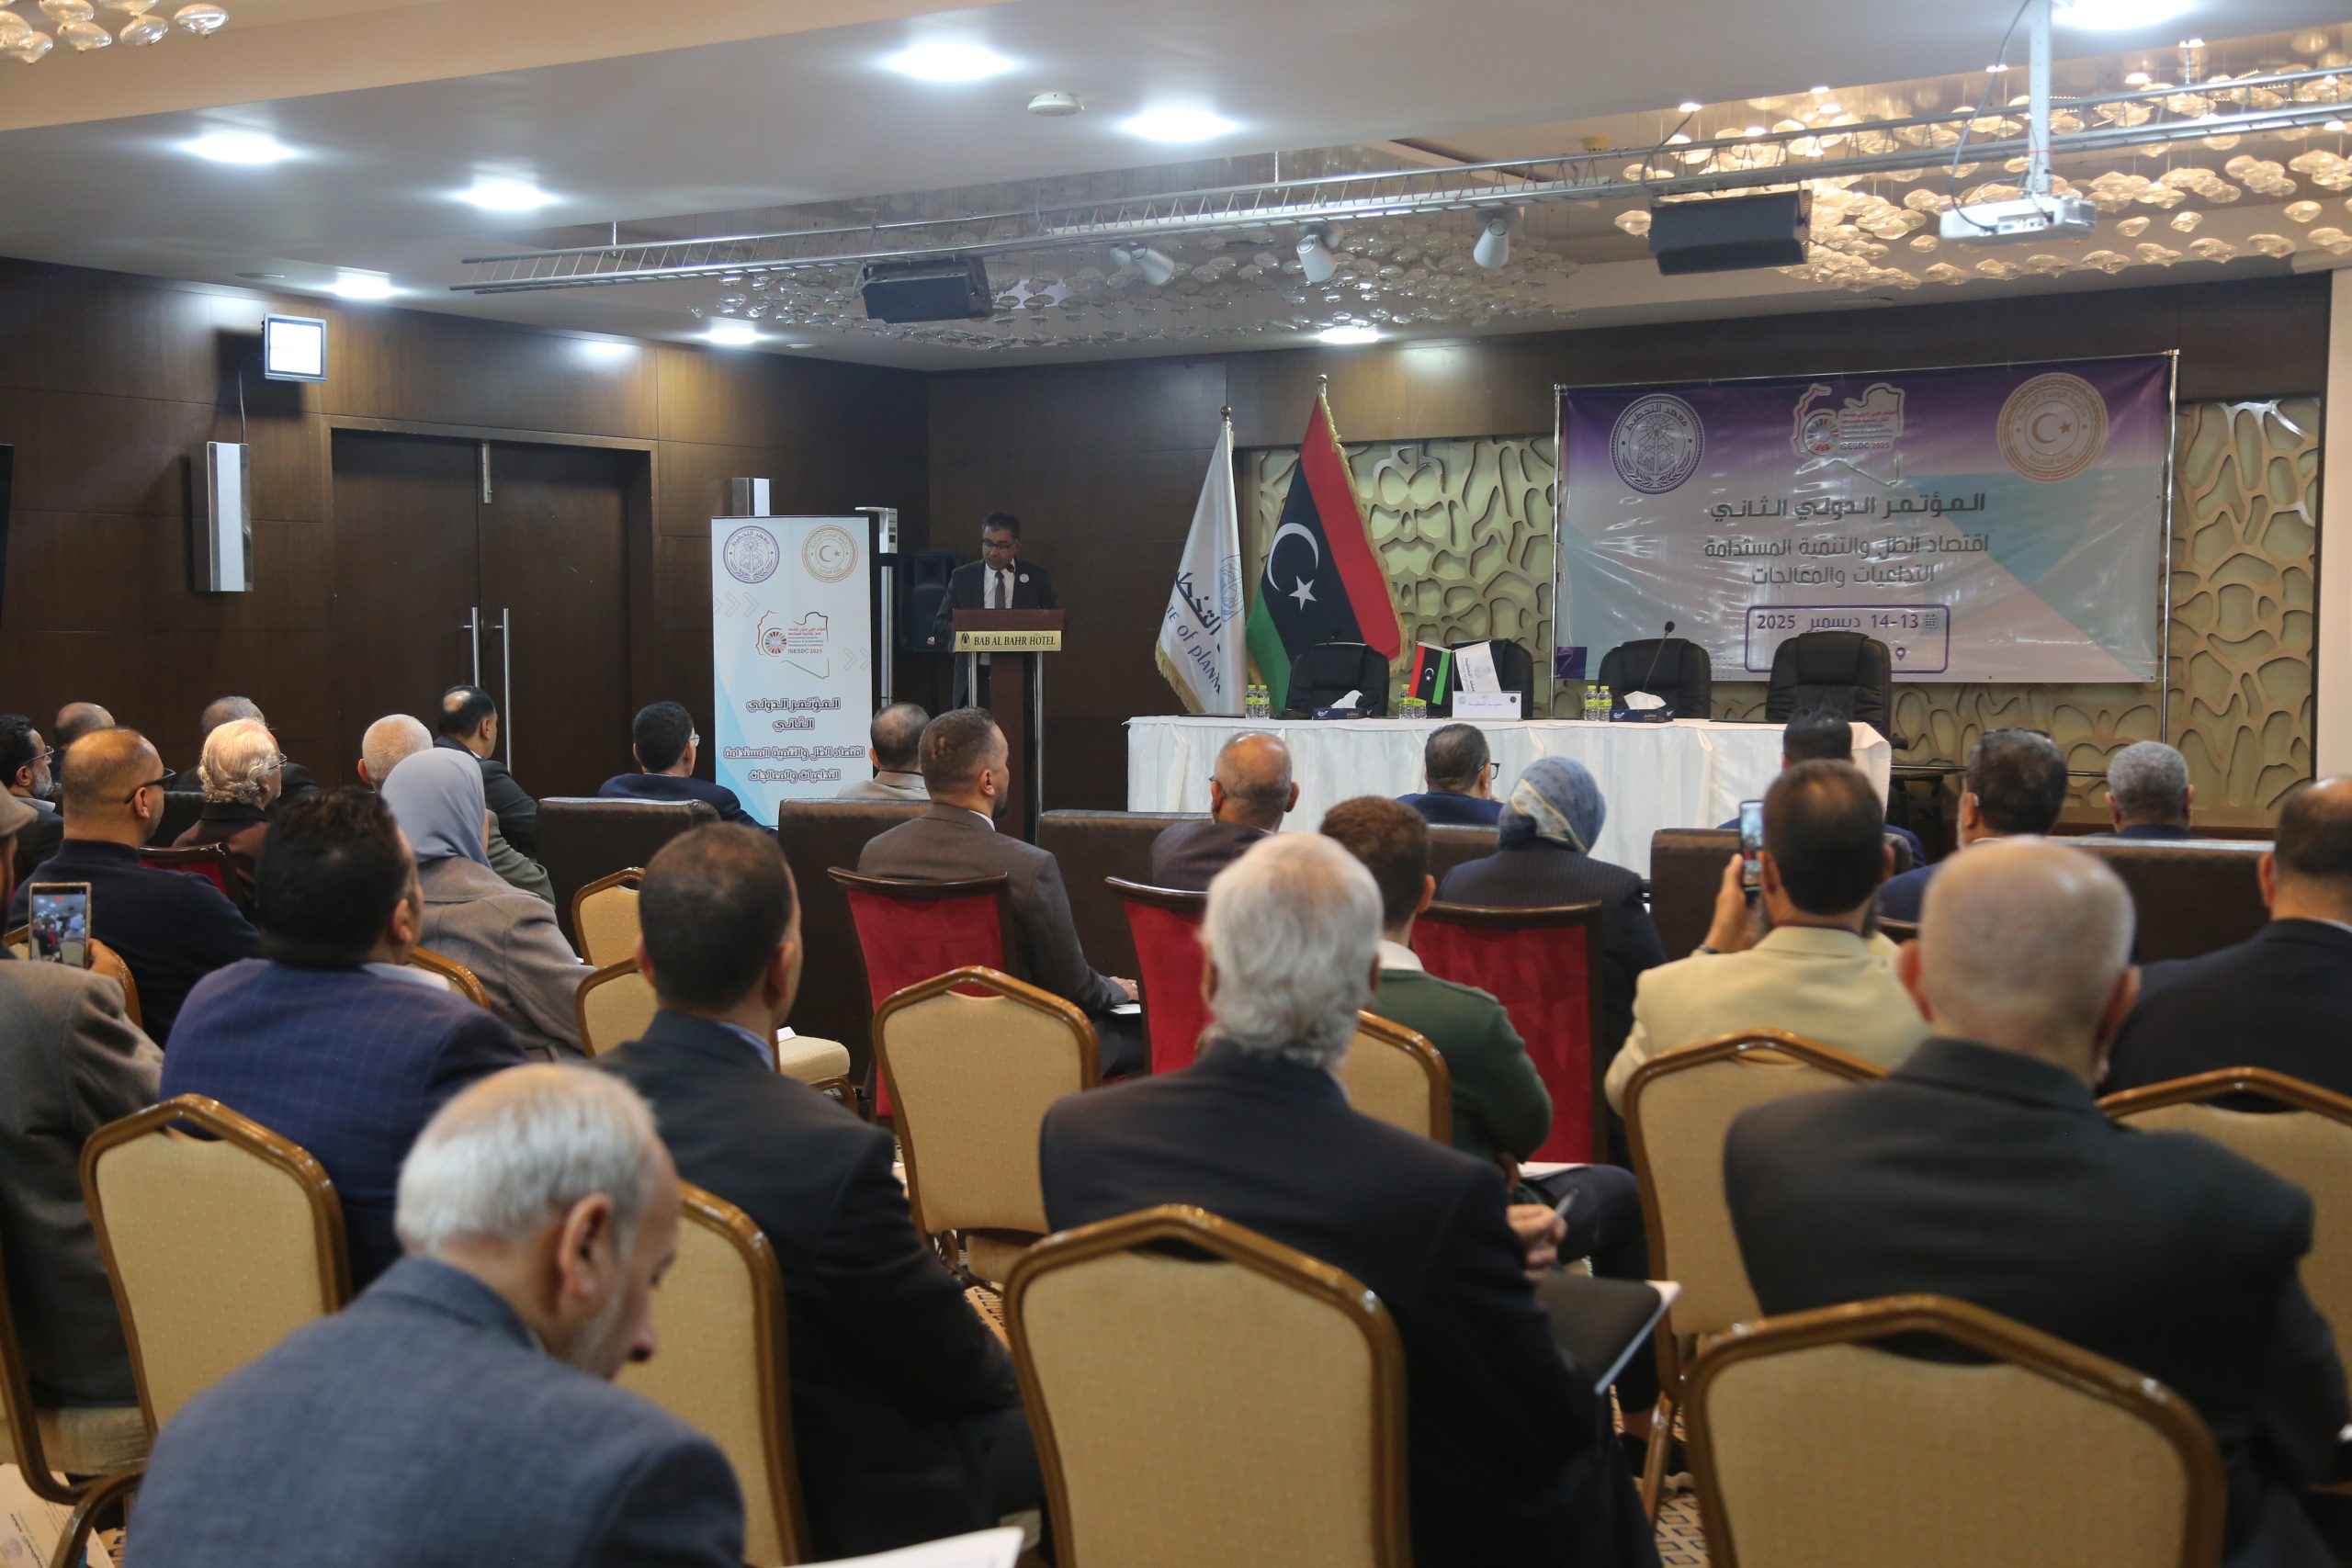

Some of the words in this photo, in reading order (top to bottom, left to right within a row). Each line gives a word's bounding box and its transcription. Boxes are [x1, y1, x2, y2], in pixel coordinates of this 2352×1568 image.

[1711, 495, 1788, 523] الثاني
[1794, 496, 1876, 522] الدولي
[1881, 491, 1984, 519] المؤتمر
[1704, 537, 1792, 558] المستدامة
[1799, 536, 1871, 559] والتنمية
[1878, 535, 1920, 559] الظل
[1928, 533, 1988, 552] اقتصاد
[1751, 567, 1846, 588] والمعالجات
[1853, 564, 1936, 588] التداعيات
[1757, 615, 1796, 629] 2025
[1806, 616, 1861, 633] ديسمبر
[974, 637, 990, 646] BAB
[991, 637, 1002, 646] AL
[1004, 636, 1027, 646] BAHR
[1029, 636, 1056, 646] HOTEL
[746, 697, 789, 713] الدولي
[790, 696, 841, 712] المؤتمر
[773, 716, 815, 732] الثاني
[724, 746, 771, 760] المستدامة
[771, 746, 808, 761] والتنمية
[809, 746, 832, 761] الظل
[832, 746, 865, 759] اقتصاد
[749, 769, 797, 784] والمعالجات
[798, 769, 842, 783] التداعيات
